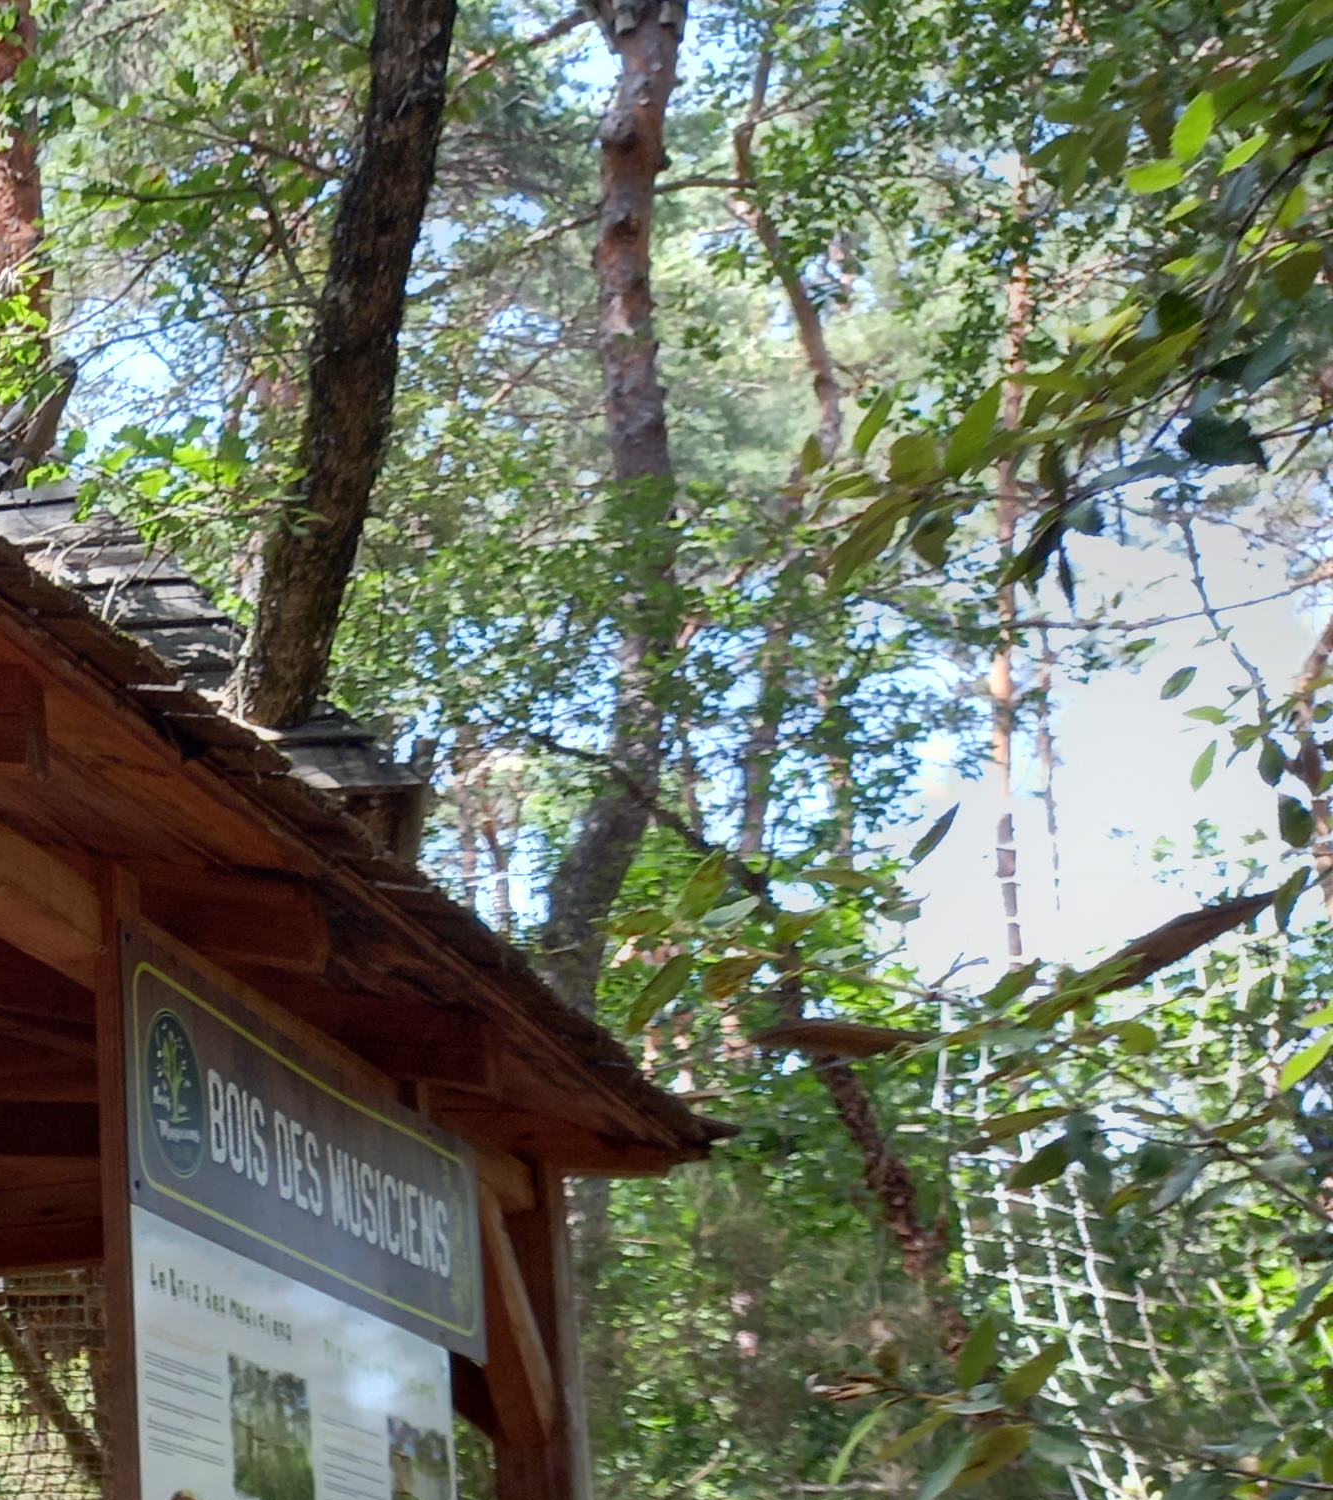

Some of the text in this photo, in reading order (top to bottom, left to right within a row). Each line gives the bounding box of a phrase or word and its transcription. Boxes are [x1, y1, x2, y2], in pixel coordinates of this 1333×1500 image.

[206, 1068, 452, 1279] BOIS DES MUSICIENS
